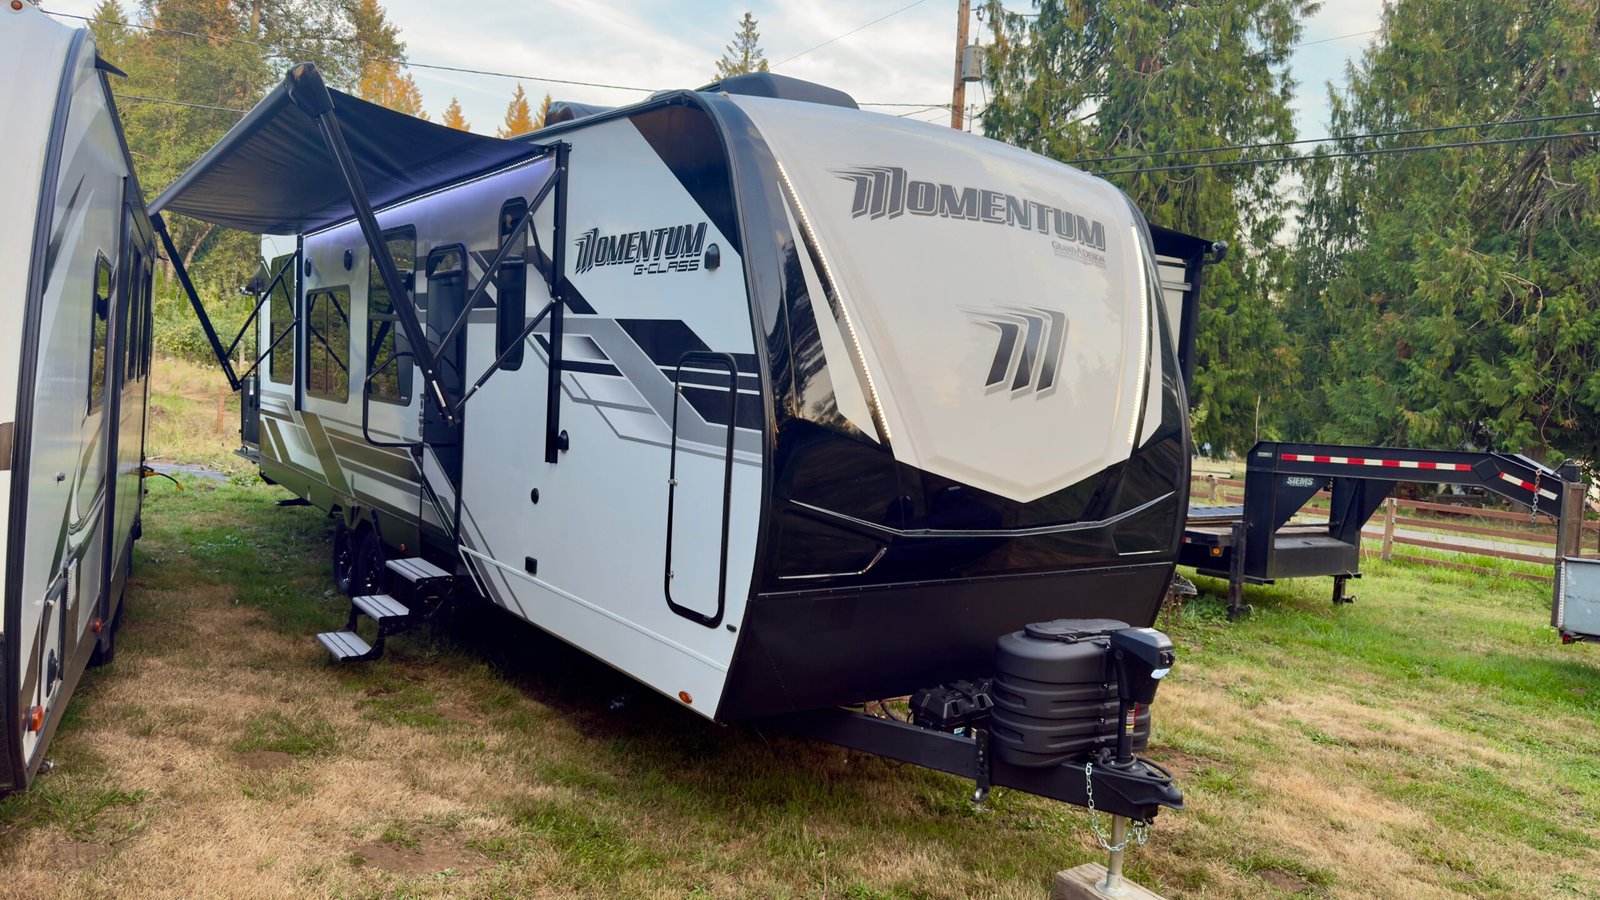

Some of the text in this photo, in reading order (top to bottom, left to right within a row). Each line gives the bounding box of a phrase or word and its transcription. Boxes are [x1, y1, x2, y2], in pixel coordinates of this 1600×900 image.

[830, 166, 1106, 252] MOMENTUM
[574, 222, 708, 275] MOMENTUM
[633, 259, 701, 276] G-CLASS
[1286, 476, 1314, 486] SIEMS
